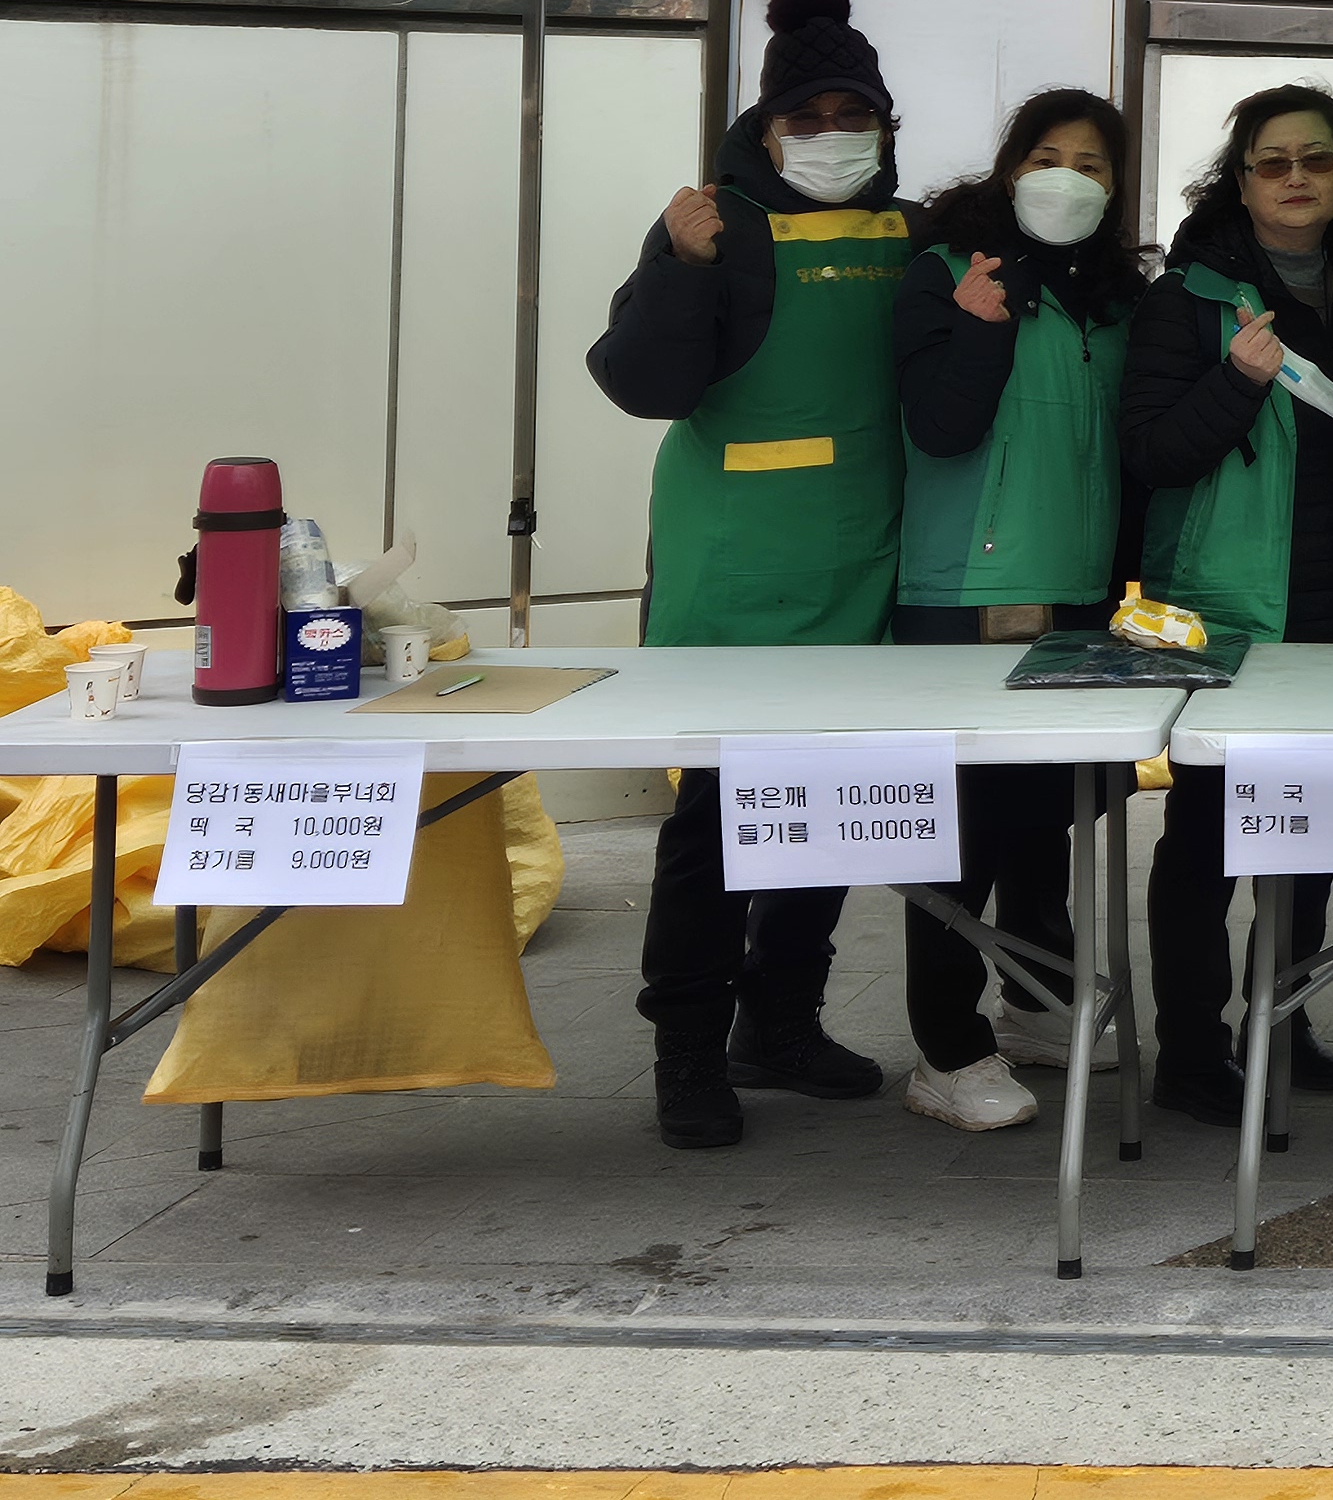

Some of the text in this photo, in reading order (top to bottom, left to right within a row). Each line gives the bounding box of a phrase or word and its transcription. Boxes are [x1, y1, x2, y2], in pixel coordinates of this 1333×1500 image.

[186, 781, 397, 804] 당감1동새마을부녀회
[735, 786, 807, 810] 볶은깨
[737, 822, 810, 846] 들기름
[1240, 814, 1310, 835] 참기름
[189, 849, 256, 871] 참기름
